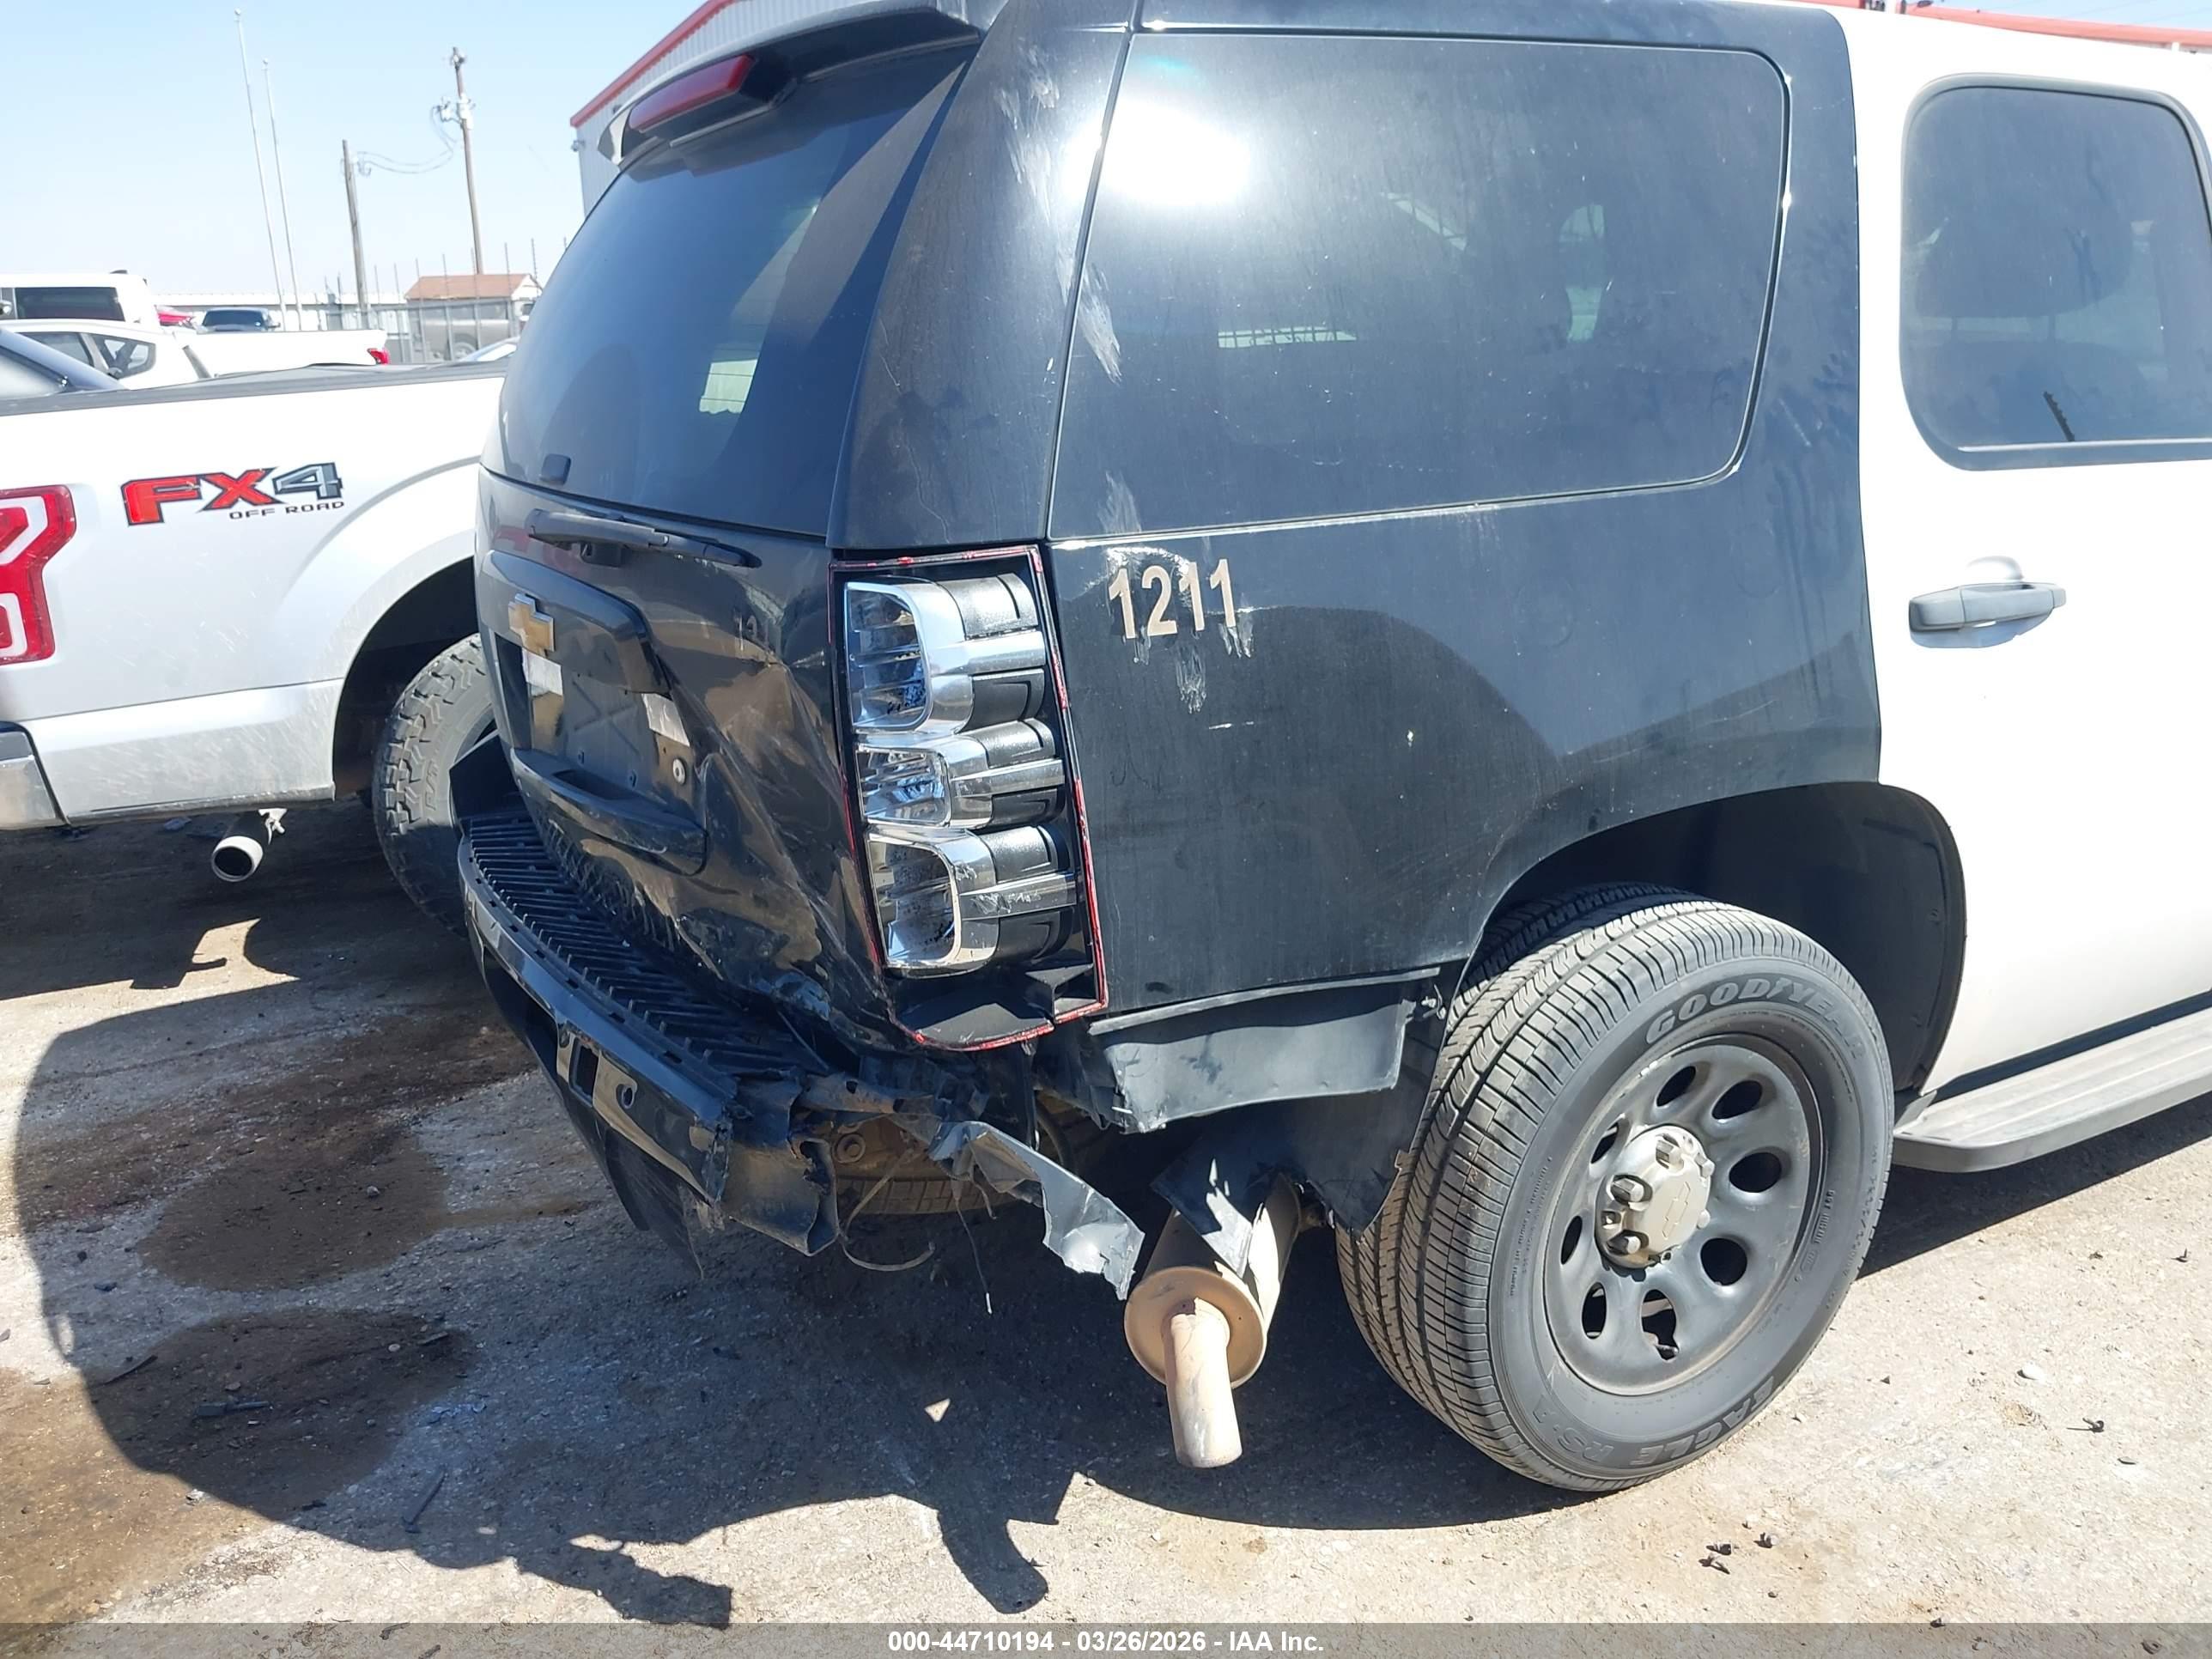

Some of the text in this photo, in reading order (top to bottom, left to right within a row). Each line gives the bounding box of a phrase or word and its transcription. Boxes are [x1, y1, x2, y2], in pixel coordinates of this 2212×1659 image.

[121, 462, 344, 526] FX4
[229, 501, 344, 520] OFF ROAD
[1108, 558, 1237, 639] 1211
[1630, 1376, 1774, 1466] EAGLE
